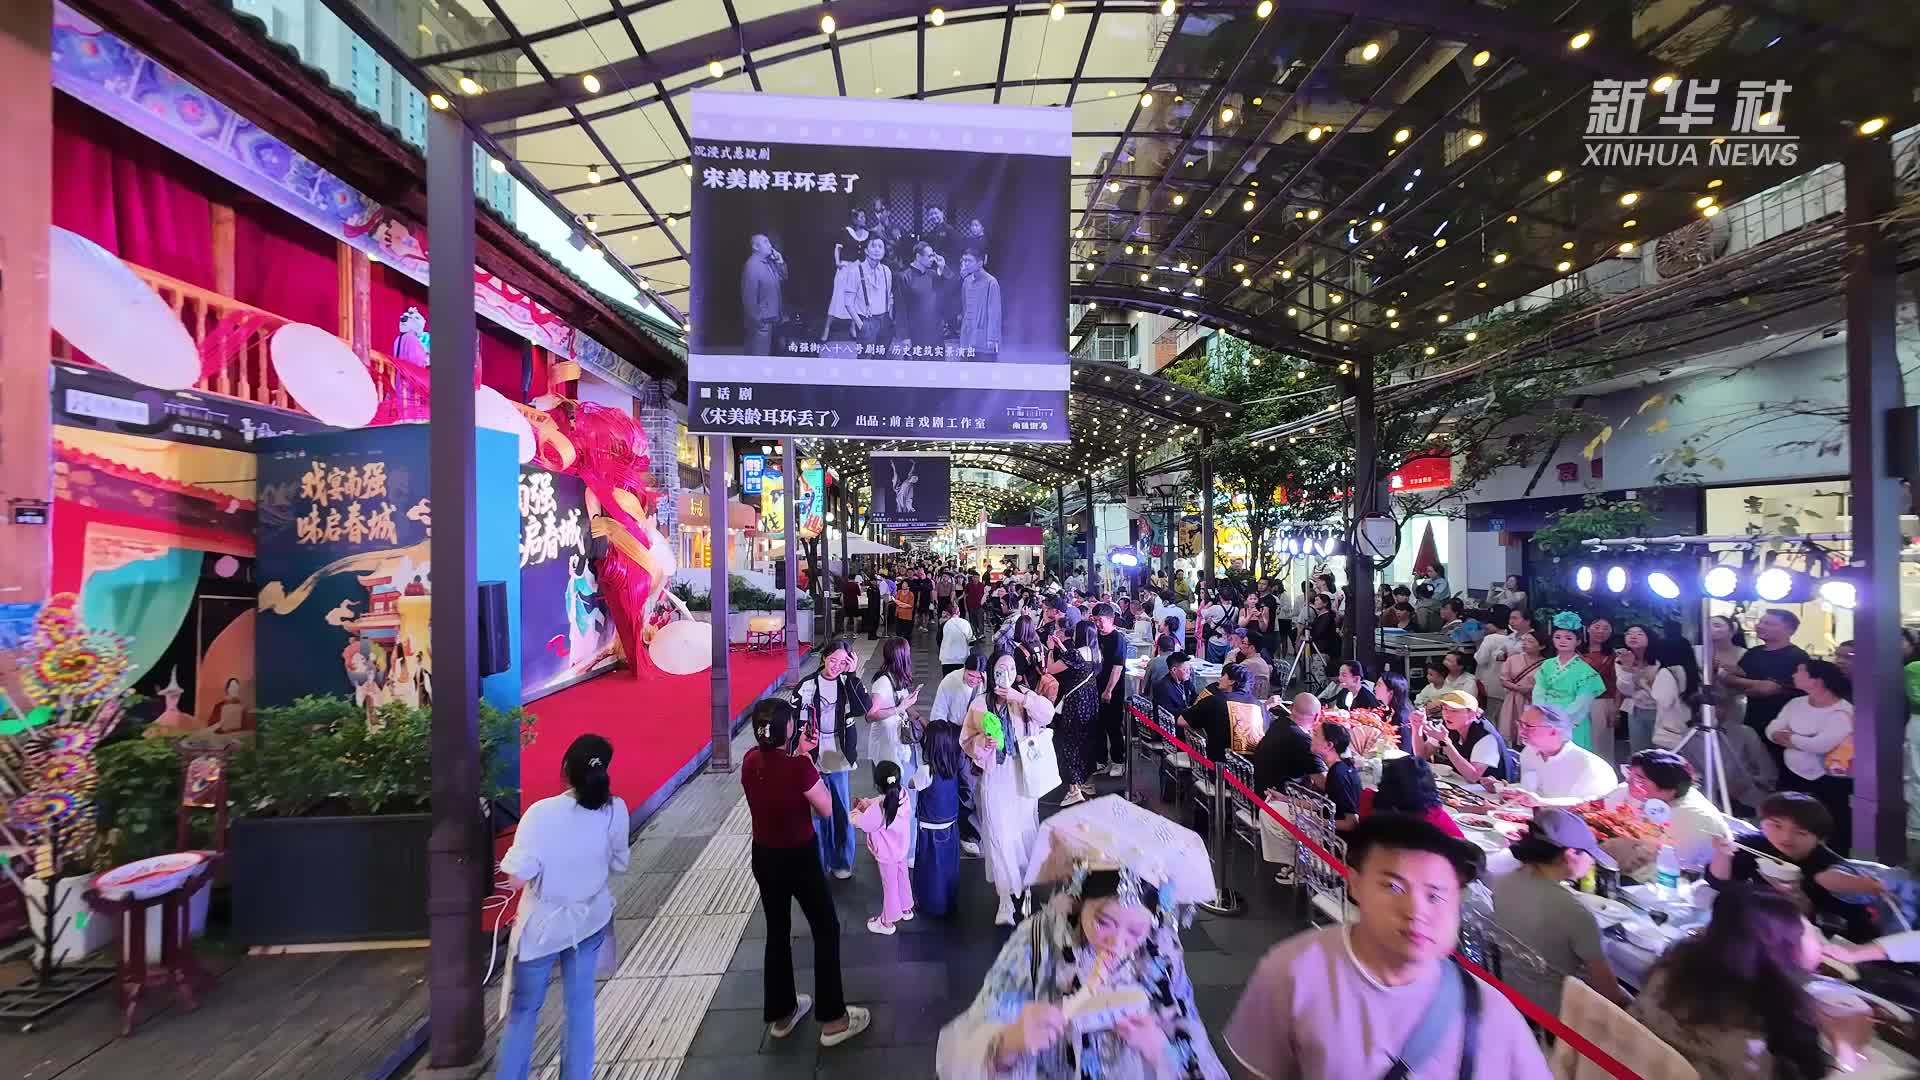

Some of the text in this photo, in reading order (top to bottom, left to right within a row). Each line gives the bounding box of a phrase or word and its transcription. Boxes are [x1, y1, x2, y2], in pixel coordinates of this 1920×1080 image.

[693, 145, 770, 160] 沉浸式悬疑剧
[702, 166, 860, 193] 宋美龄耳环丢了
[788, 341, 977, 357] 南强街八十八号剧场 历史建筑实景演出
[717, 386, 753, 400] 话剧
[700, 408, 840, 427] 《宋美龄耳环丢了》
